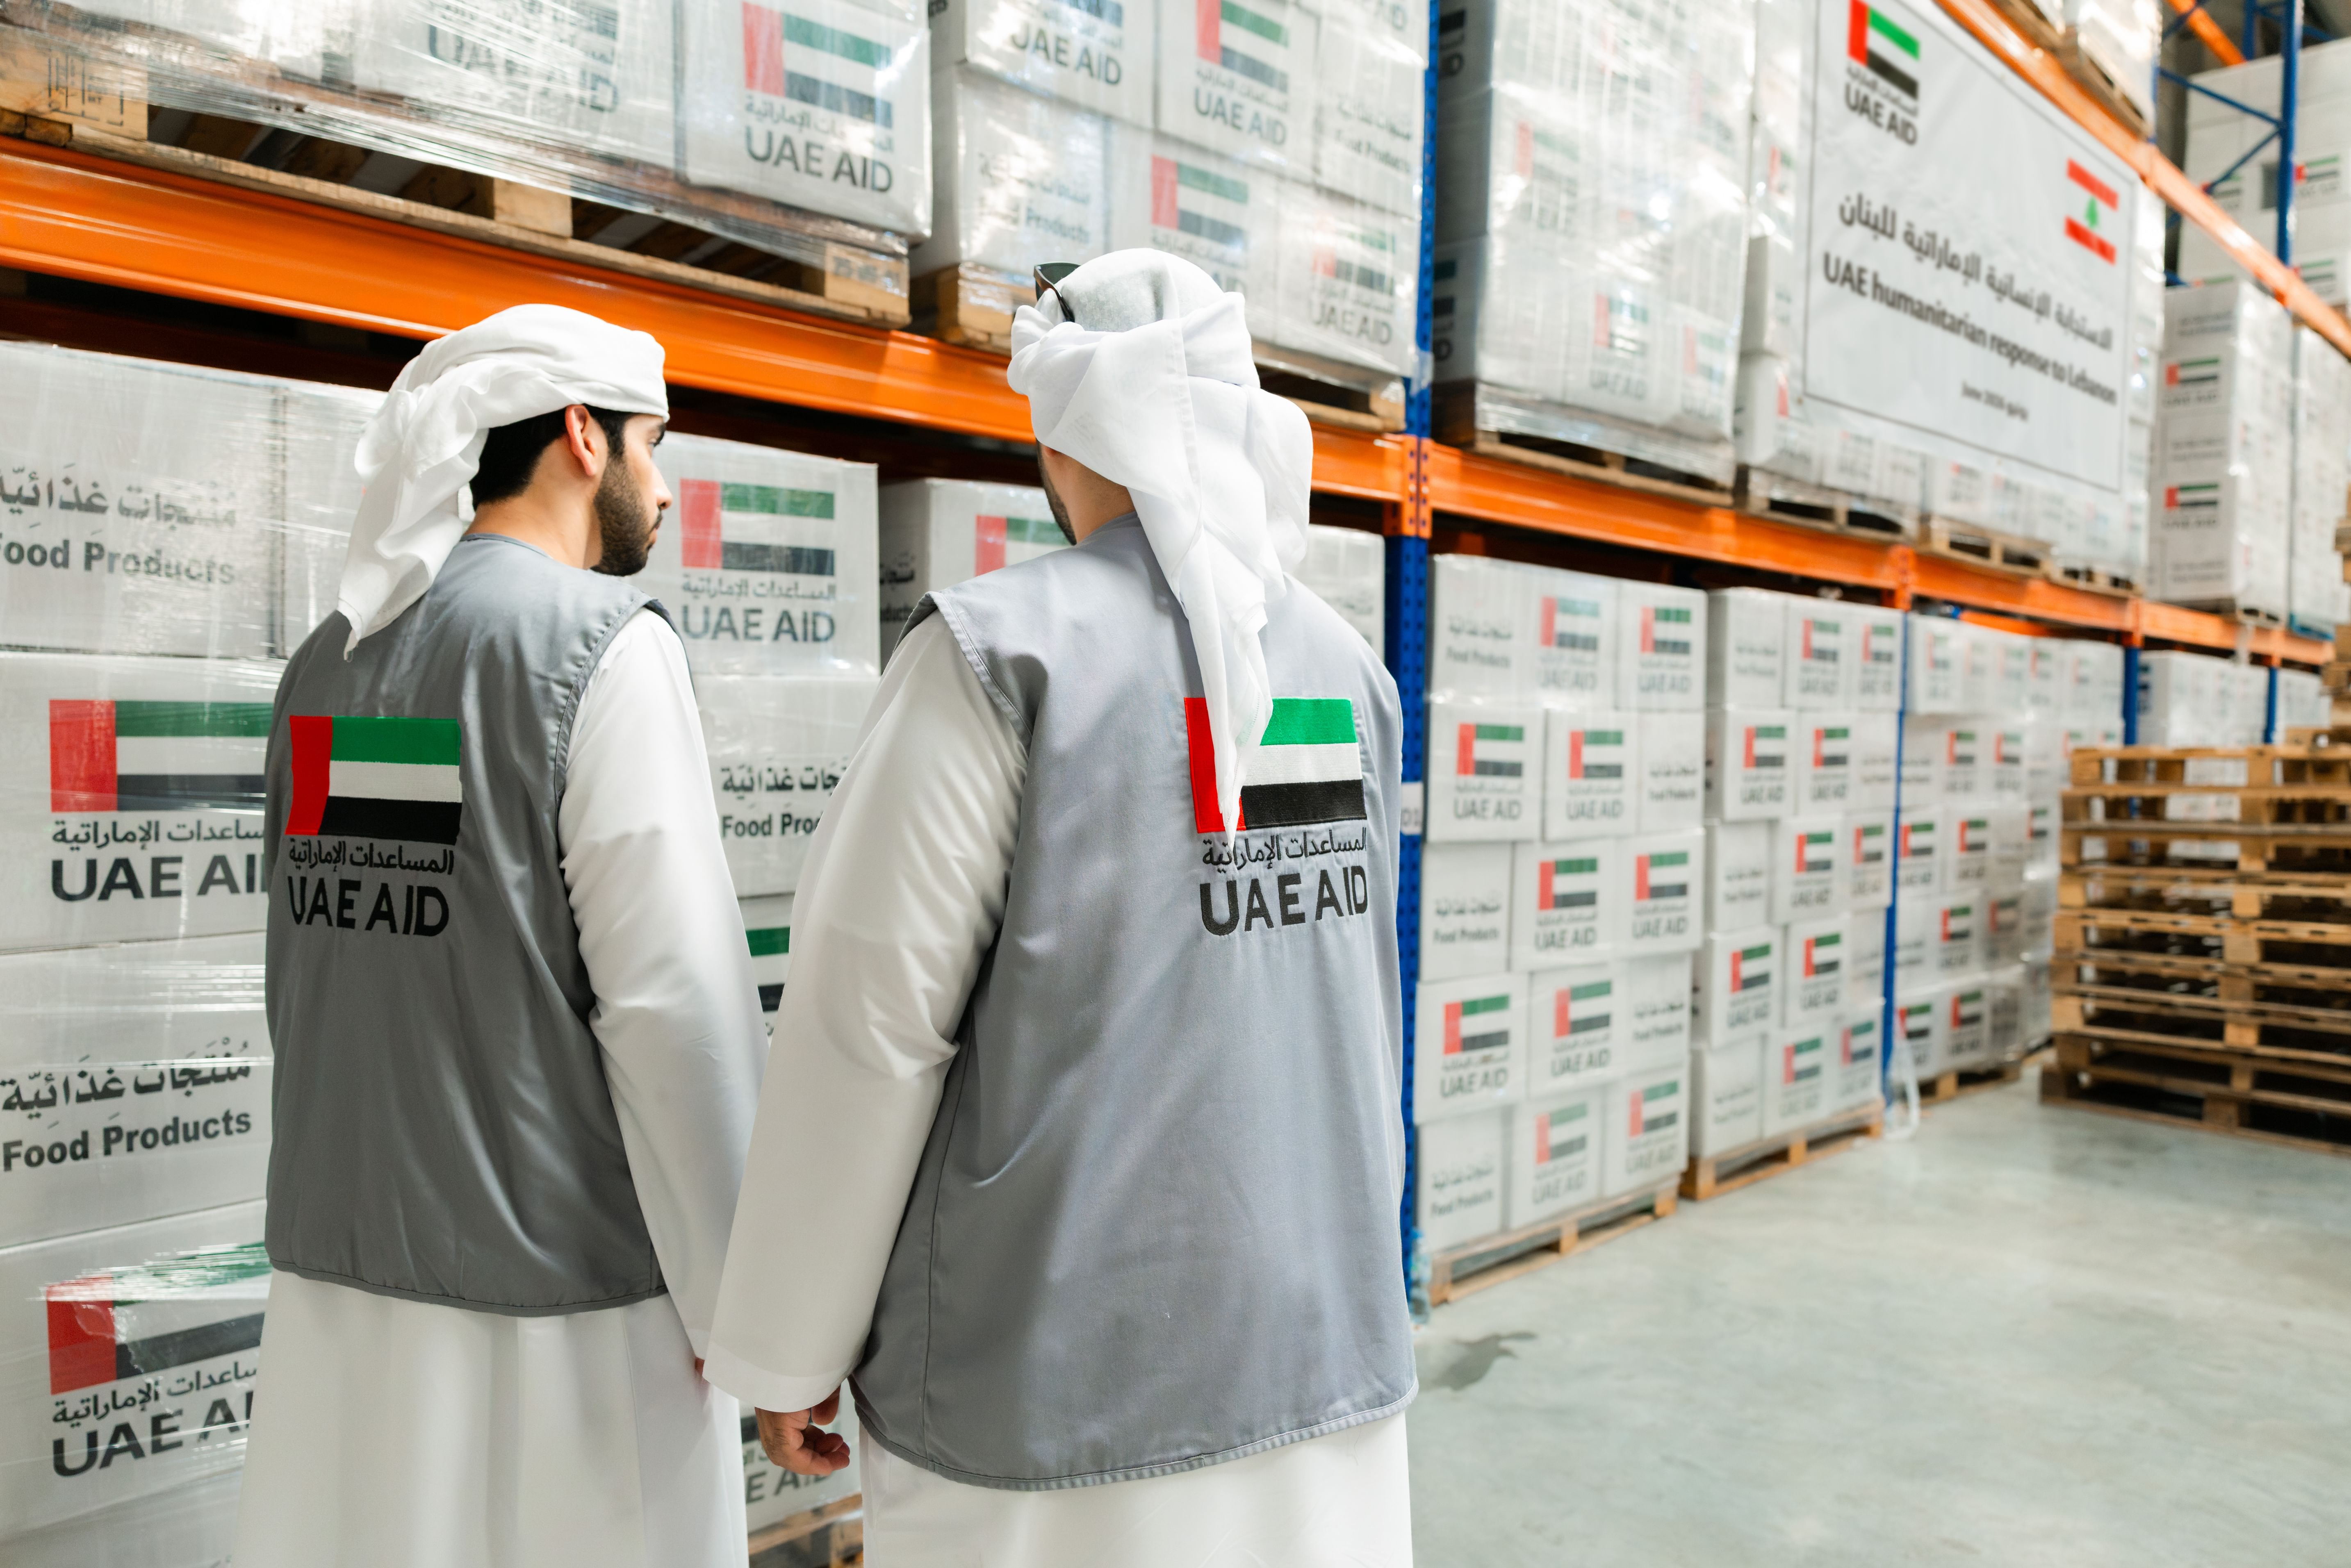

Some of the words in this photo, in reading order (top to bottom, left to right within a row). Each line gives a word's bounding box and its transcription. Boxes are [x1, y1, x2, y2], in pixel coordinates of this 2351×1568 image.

[1194, 87, 1243, 131] UAE
[1844, 82, 1884, 128] UAE
[1887, 111, 1918, 146] AID
[745, 125, 825, 178] UAE
[832, 150, 893, 193] AID
[1839, 192, 1897, 241] للبنان
[1823, 250, 1868, 297] UAE
[1872, 270, 1987, 348] humanitarian
[1989, 333, 2049, 368] response
[2052, 360, 2066, 383] to
[2068, 363, 2117, 406] Lebanon
[0, 539, 70, 570] ood
[84, 540, 235, 585] Products
[681, 605, 763, 641] UAE
[773, 609, 836, 643] AID
[52, 819, 160, 851] الإماراتية
[721, 813, 772, 837] Food
[1285, 827, 1367, 859] المساعدات
[52, 856, 183, 901] UAE
[197, 853, 269, 896] AI
[289, 837, 346, 872] الإماراتية
[349, 842, 455, 875] المساعدات
[1202, 833, 1281, 874] الإماراتية
[288, 876, 361, 929] UAE
[365, 883, 450, 937] AID
[1200, 872, 1306, 936] UAE
[1314, 865, 1368, 921] AID
[3, 1130, 89, 1172] Food
[103, 1109, 251, 1156] Products
[52, 1380, 161, 1428] الإماراتية
[52, 1408, 184, 1477] UAE
[197, 1390, 254, 1443] AI
